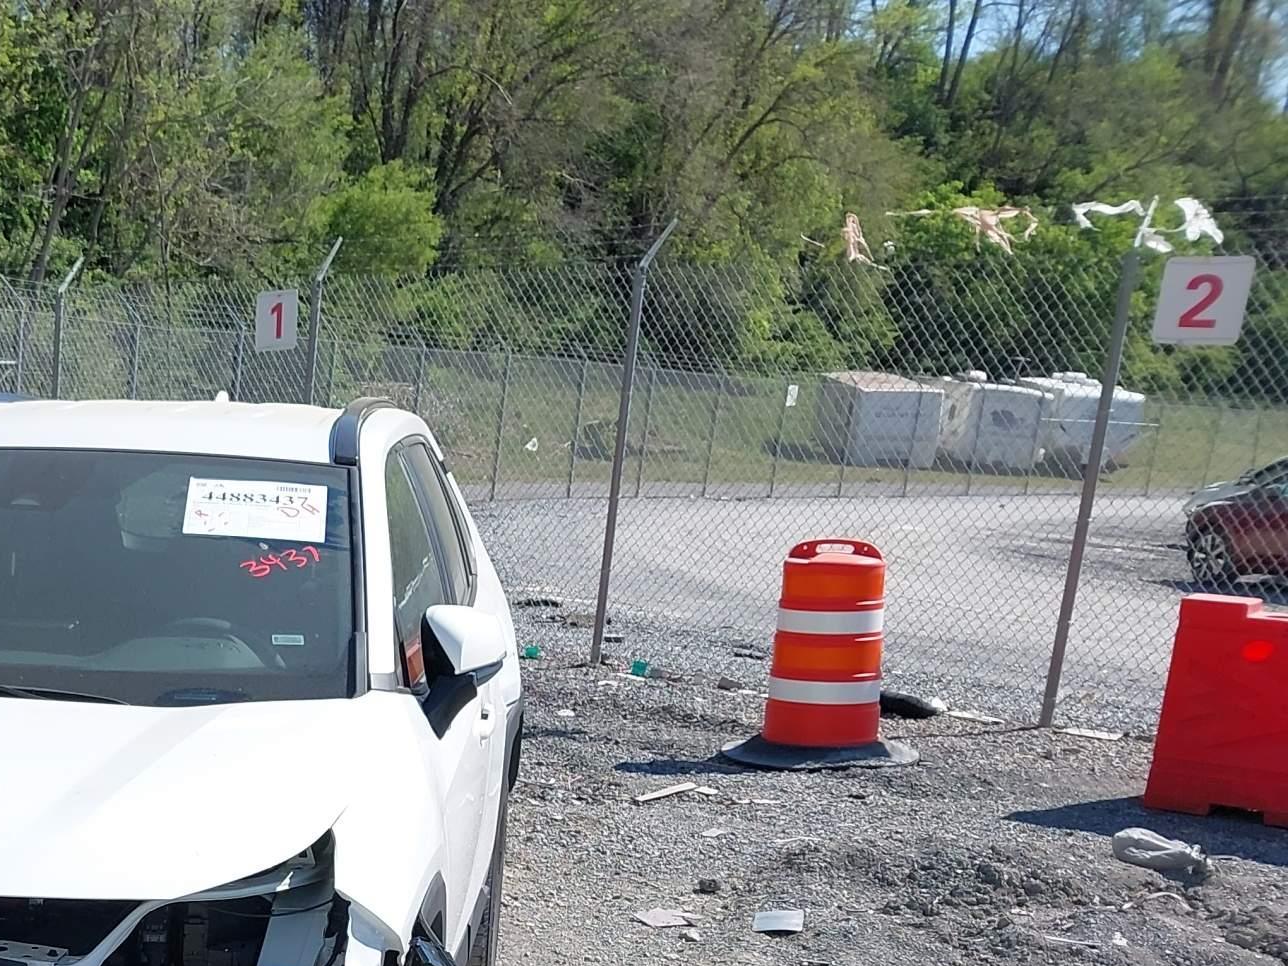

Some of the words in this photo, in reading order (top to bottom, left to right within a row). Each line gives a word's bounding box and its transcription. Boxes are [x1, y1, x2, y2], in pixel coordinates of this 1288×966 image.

[1178, 273, 1224, 328] 2
[271, 302, 283, 339] 1
[202, 491, 309, 507] 44883437
[239, 545, 320, 577] 3437
